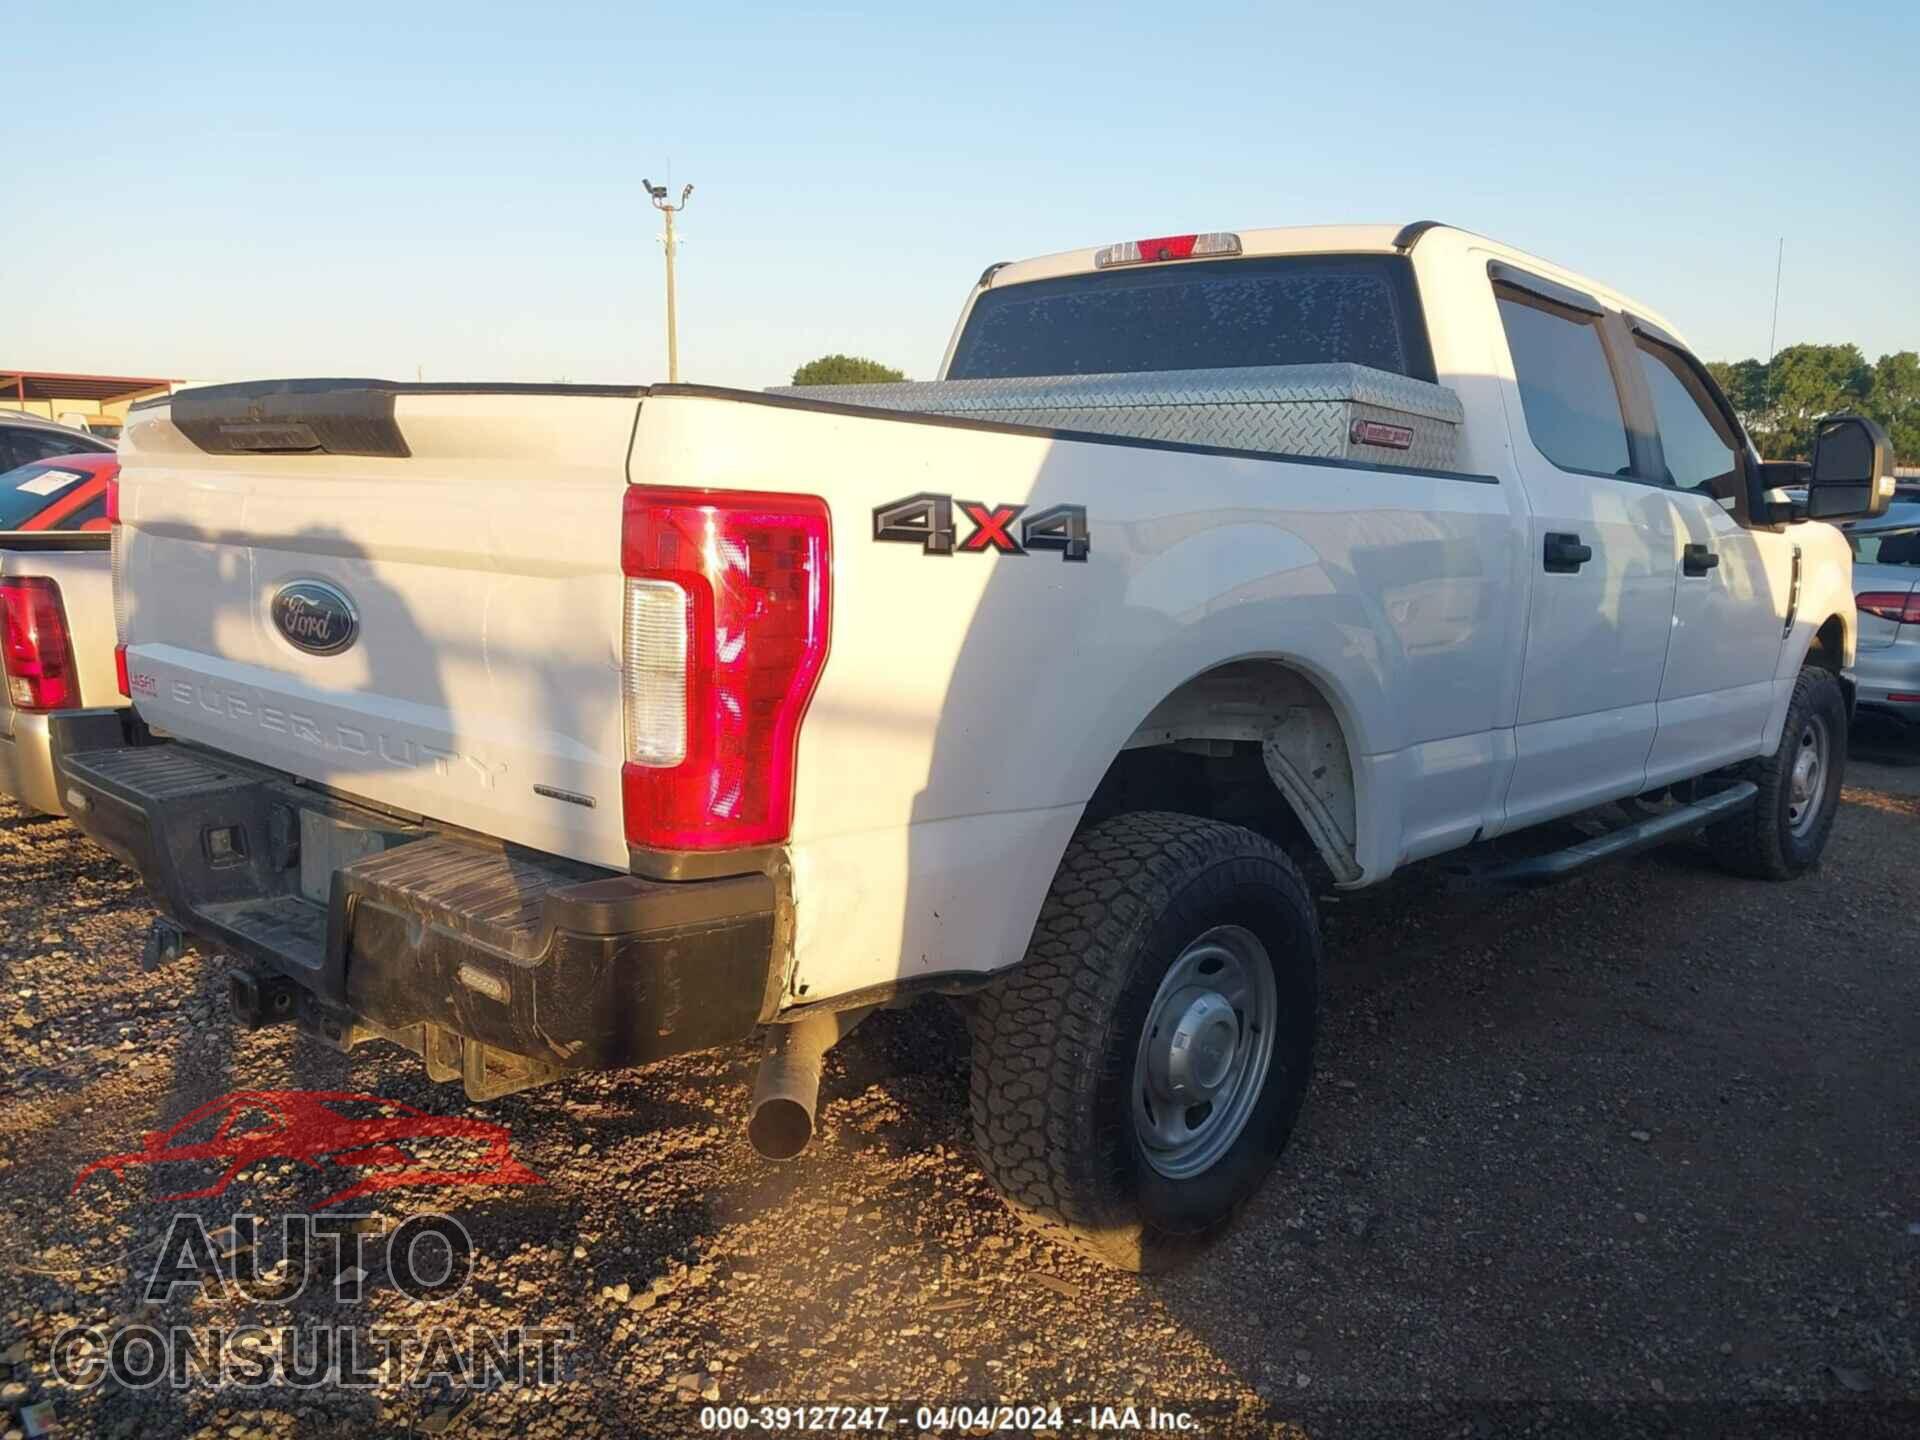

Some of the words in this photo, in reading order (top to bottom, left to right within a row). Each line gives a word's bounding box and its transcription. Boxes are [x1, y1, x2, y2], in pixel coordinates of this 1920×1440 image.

[283, 594, 334, 640] Ford
[171, 681, 322, 745] SUPER
[334, 723, 512, 792] DUTY
